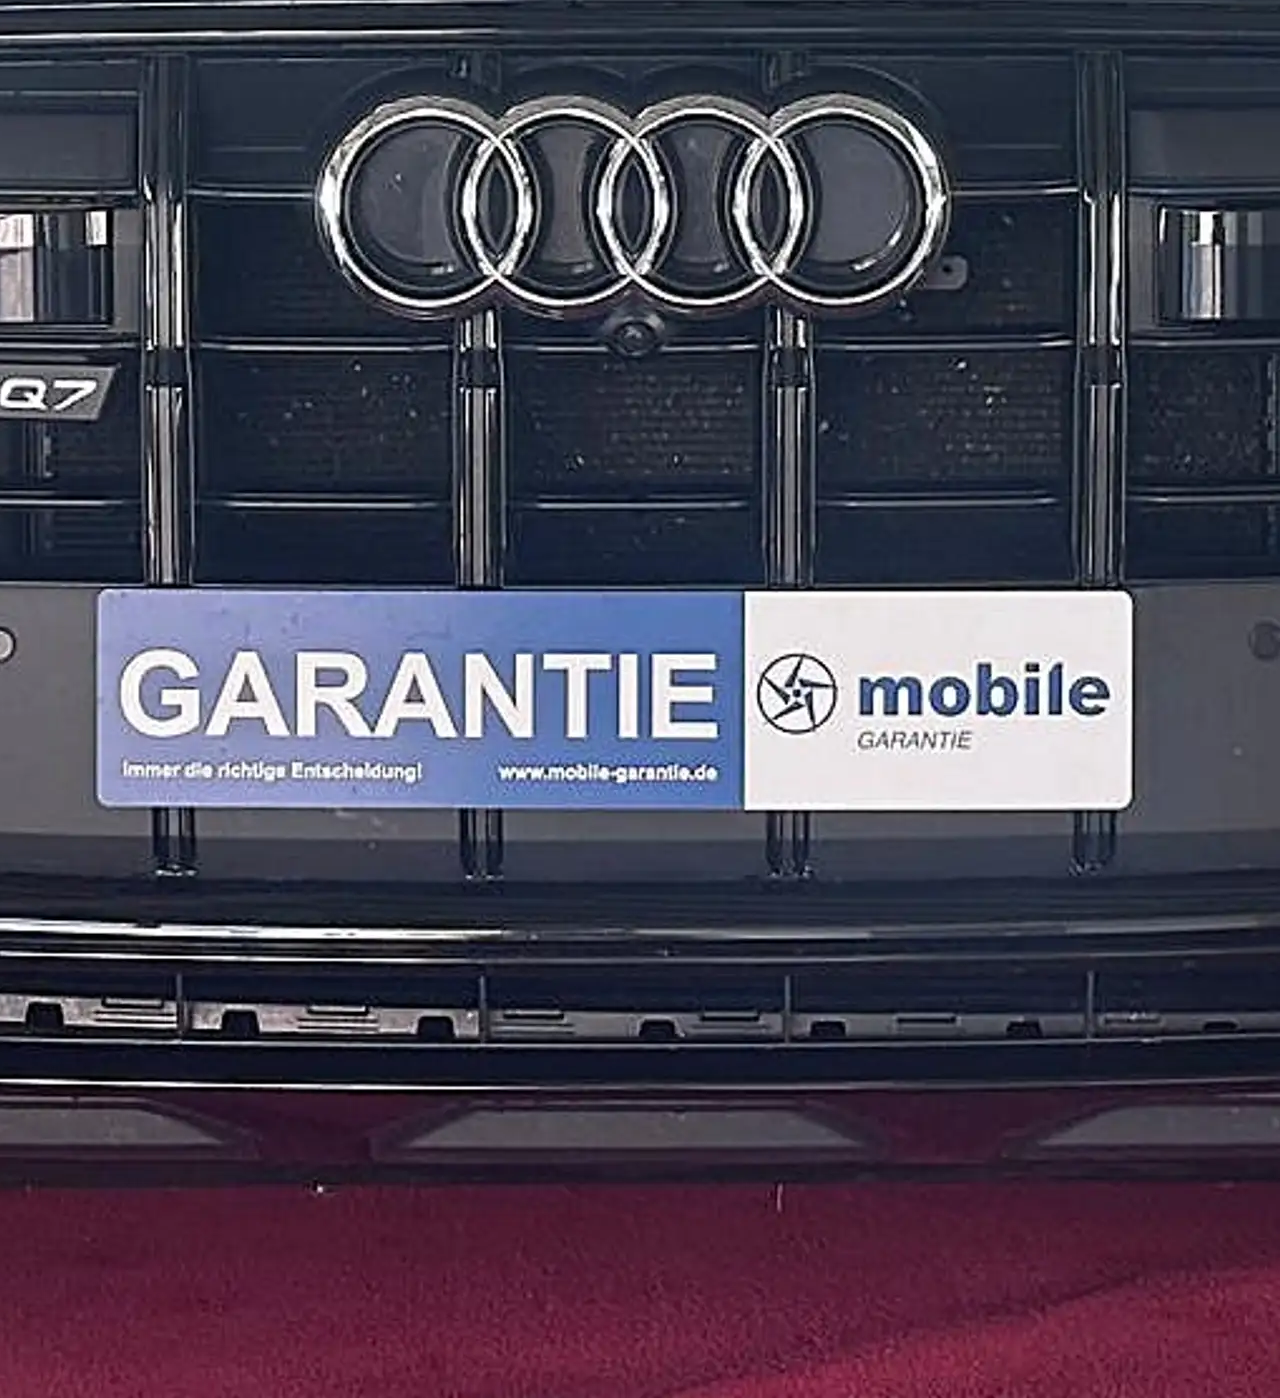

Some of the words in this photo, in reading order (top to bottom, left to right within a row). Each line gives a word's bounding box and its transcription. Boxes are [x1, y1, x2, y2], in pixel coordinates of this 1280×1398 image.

[120, 648, 719, 738] GARANTIE
[858, 662, 1111, 716] mobile
[857, 730, 972, 750] GARANTIE
[123, 760, 181, 778] Immer
[184, 761, 212, 778] die
[218, 761, 285, 782] richtige
[291, 761, 423, 783] Entscheidung!
[499, 762, 718, 783] www.mobile-garantie.de
